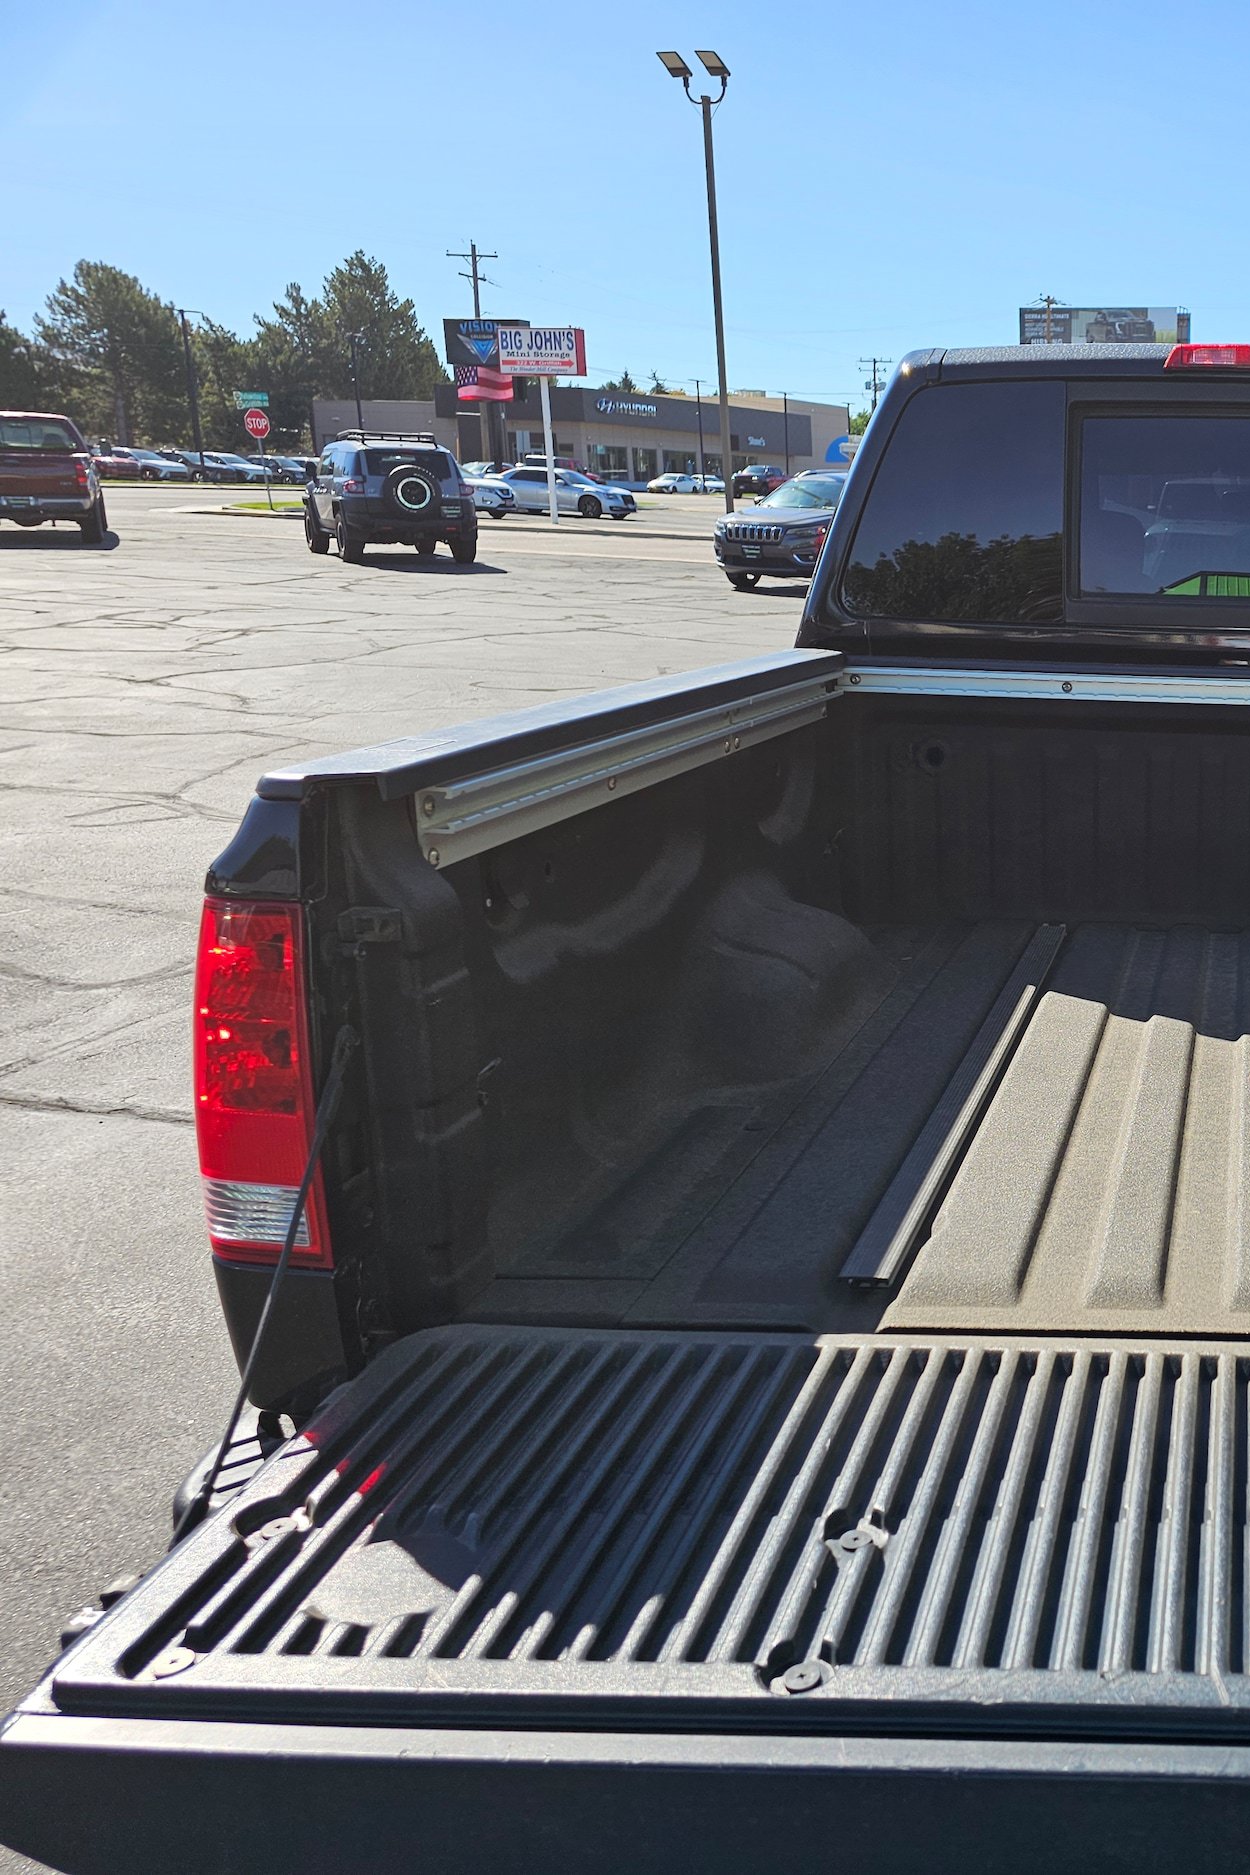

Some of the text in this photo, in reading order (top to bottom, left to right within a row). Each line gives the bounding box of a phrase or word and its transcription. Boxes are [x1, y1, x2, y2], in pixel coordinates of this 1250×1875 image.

[500, 330, 574, 351] BIG JOHN'S
[533, 351, 571, 359] Storage
[616, 401, 657, 417] HYUNDAI
[247, 417, 267, 429] STOP
